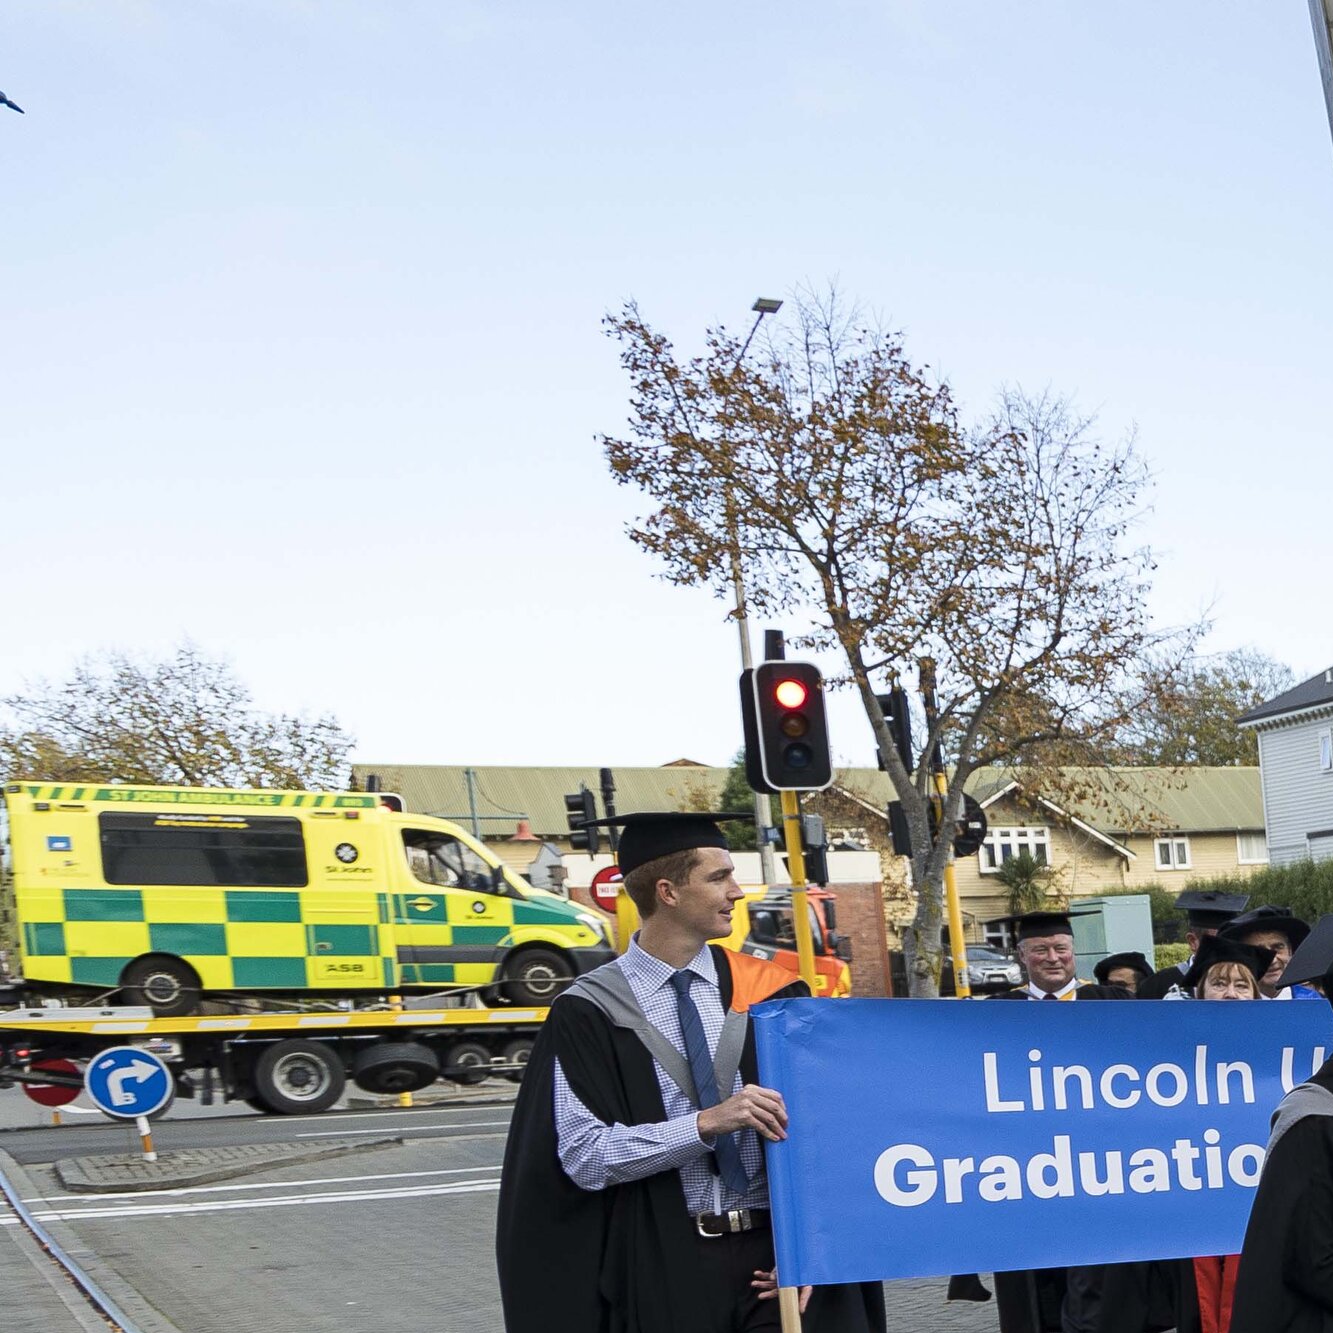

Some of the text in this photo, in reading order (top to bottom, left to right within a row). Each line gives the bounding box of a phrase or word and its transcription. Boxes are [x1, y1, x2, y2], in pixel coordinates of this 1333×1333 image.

[109, 790, 276, 806] ST JOHN AMBULANCE
[983, 1045, 1256, 1113] Lincoln
[873, 1128, 1267, 1207] Graduatio
